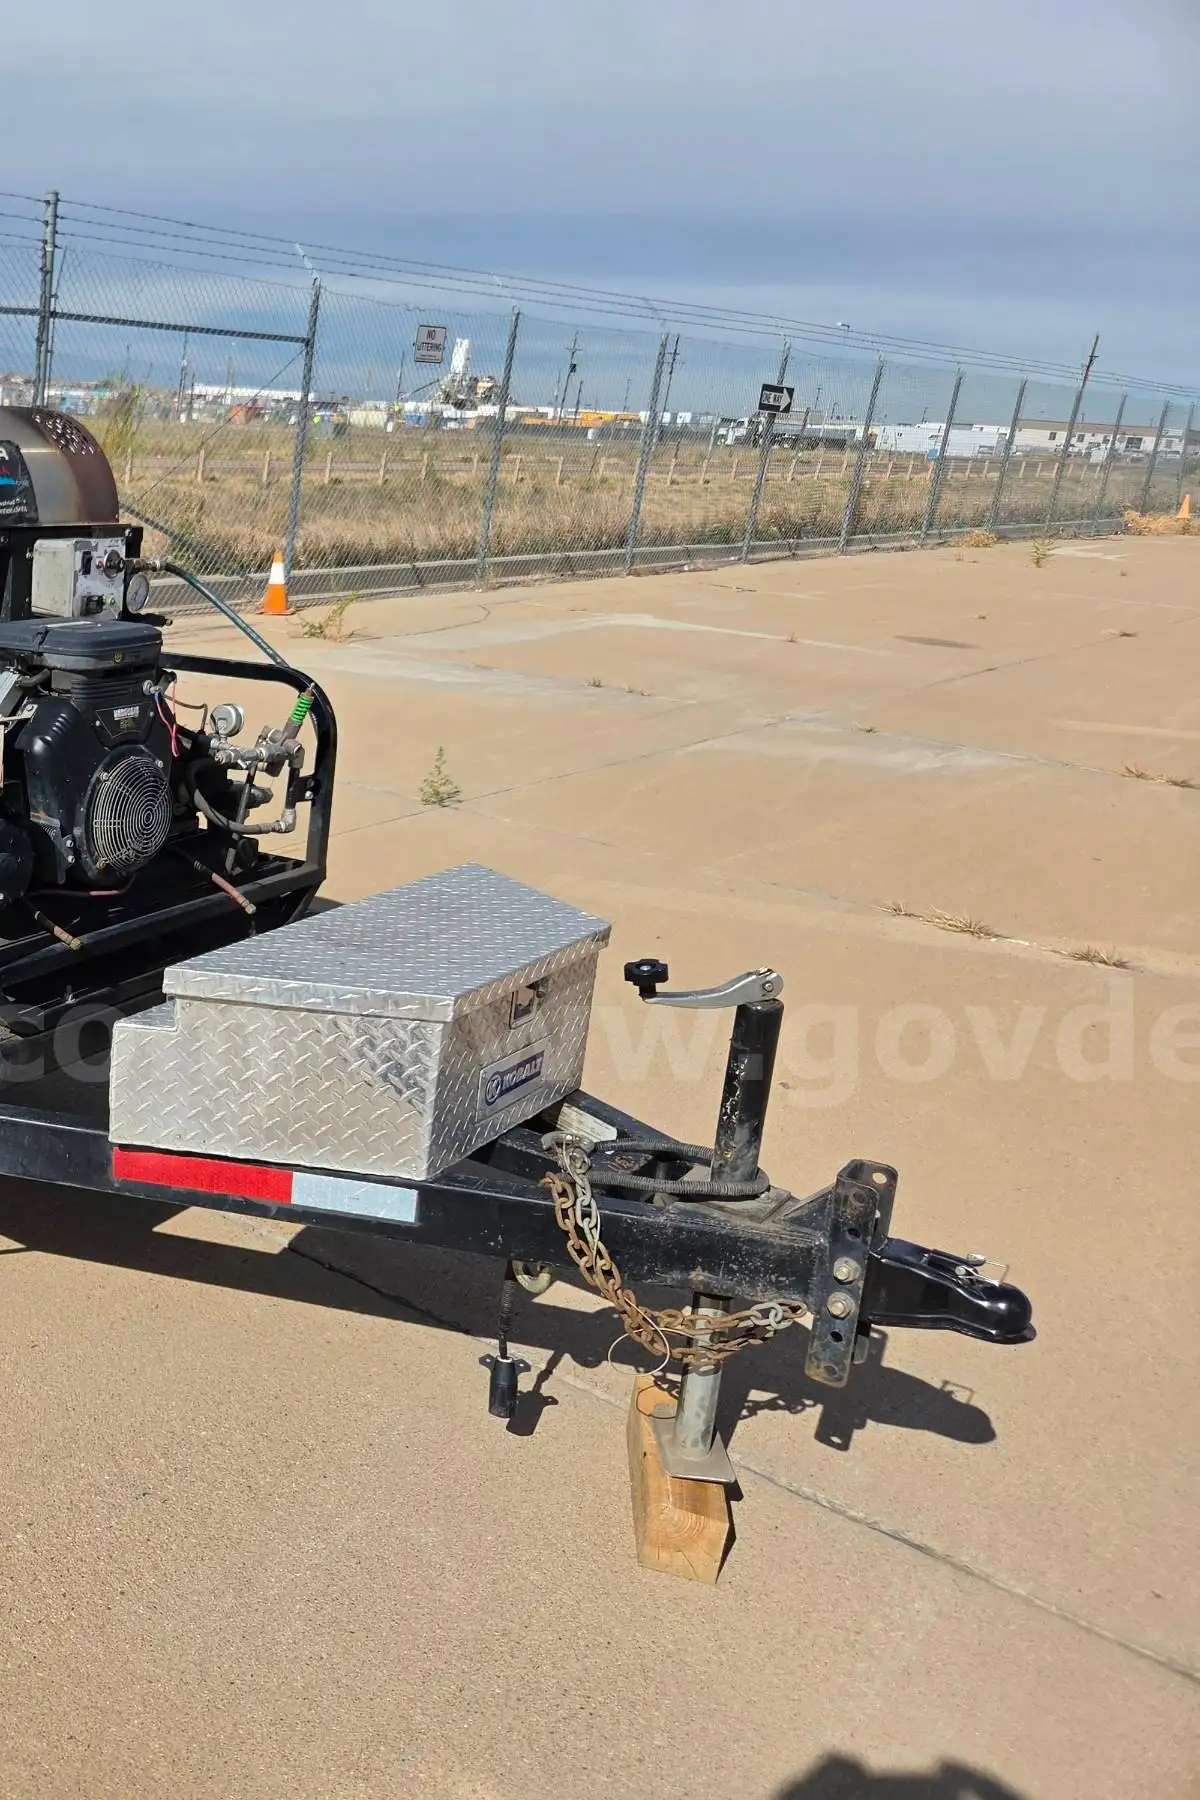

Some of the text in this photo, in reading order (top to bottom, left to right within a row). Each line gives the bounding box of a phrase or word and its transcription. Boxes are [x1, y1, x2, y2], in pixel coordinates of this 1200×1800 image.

[426, 329, 437, 341] NO
[773, 393, 783, 405] WAY
[502, 1056, 543, 1091] KOBALT
